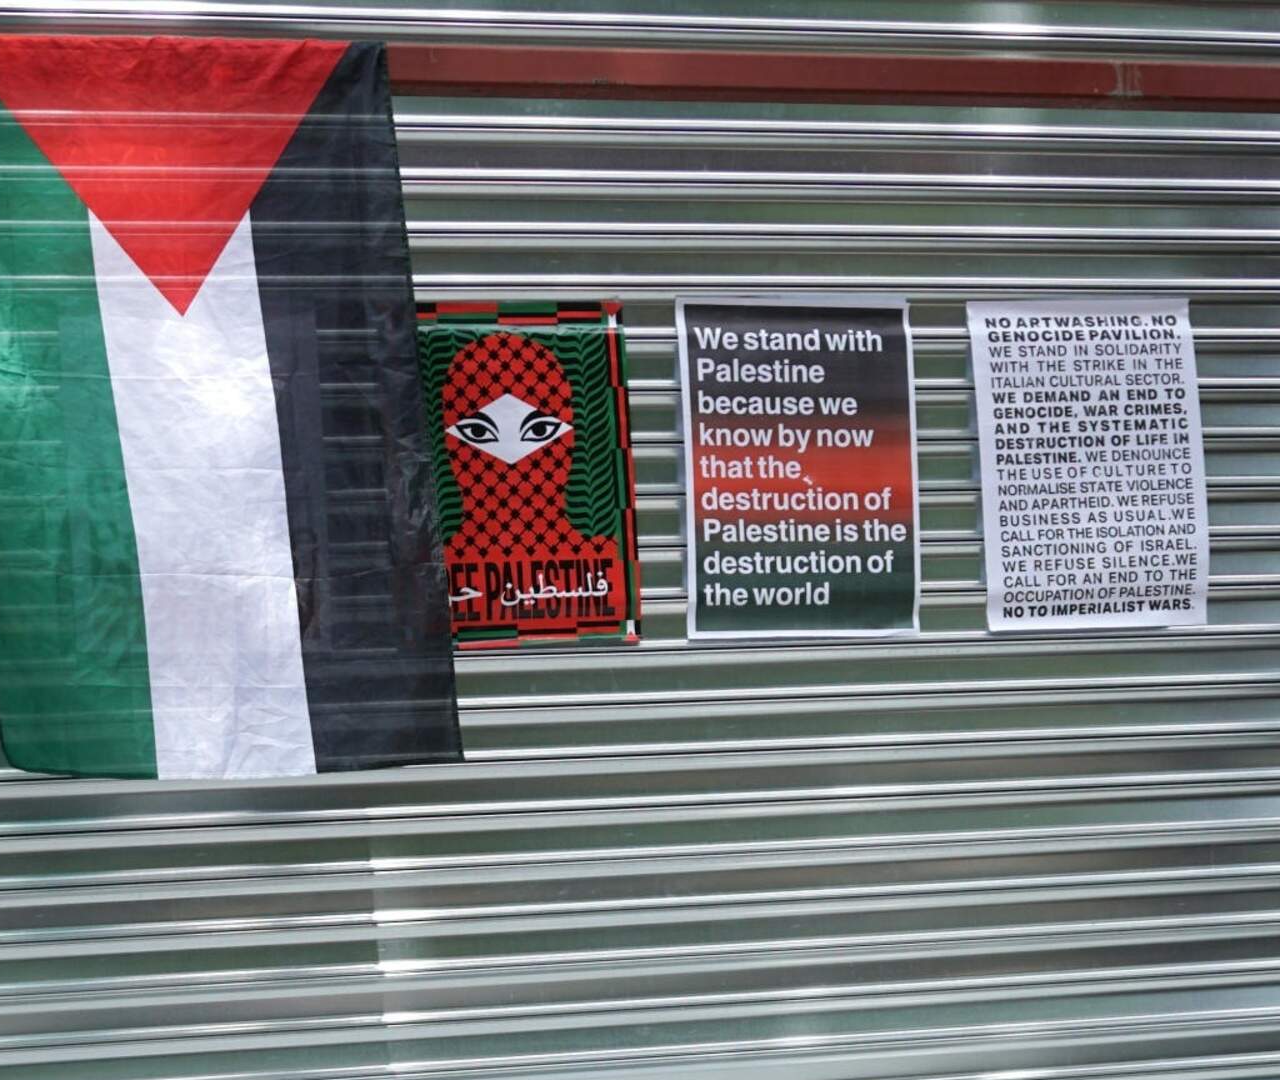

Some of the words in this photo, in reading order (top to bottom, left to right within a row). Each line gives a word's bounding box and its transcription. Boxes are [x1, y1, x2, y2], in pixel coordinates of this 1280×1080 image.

[985, 317, 1011, 329] NO
[1016, 315, 1149, 328] ARTWASHING.
[1152, 315, 1177, 327] NO
[694, 327, 738, 350] We
[744, 329, 820, 351] stand
[825, 329, 882, 352] with
[988, 330, 1086, 343] GENOCIDE
[1090, 329, 1181, 341] PAVILION.
[989, 346, 1012, 358] WE
[1018, 345, 1067, 357] STAND
[1074, 345, 1088, 356] IN
[1095, 343, 1182, 356] SOLIDARITY
[697, 358, 825, 383] Palestine
[990, 361, 1028, 373] WITH
[1038, 360, 1066, 372] THE
[1074, 359, 1125, 372] STRIKE
[1133, 359, 1147, 370] IN
[1155, 358, 1183, 370] THE
[991, 376, 1045, 389] ITALIAN
[1050, 375, 1120, 387] CULTURAL
[1125, 373, 1184, 386] SECTOR.
[698, 390, 814, 415] because
[820, 397, 858, 415] we
[993, 392, 1016, 404] WE
[1023, 390, 1090, 403] DEMAND
[1099, 389, 1120, 401] AN
[1127, 389, 1157, 400] END
[1165, 388, 1185, 400] TO
[993, 407, 1078, 420] GENOCIDE,
[1084, 405, 1118, 417] WAR
[1124, 403, 1187, 416] CRIMES,
[995, 422, 1030, 434] AND
[1038, 421, 1071, 433] THE
[1078, 418, 1188, 432] SYSTEMATIC
[700, 423, 773, 447] know
[778, 424, 811, 453] by
[817, 429, 874, 447] now
[996, 435, 1105, 450] DESTRUCTION
[1111, 435, 1130, 447] OF
[1137, 434, 1168, 446] LIFE
[1174, 433, 1189, 445] IN
[996, 452, 1082, 465] PALESTINE.
[1085, 451, 1107, 463] WE
[1112, 448, 1190, 462] DENOUNCE
[700, 455, 752, 479] that
[757, 456, 801, 479] the
[998, 468, 1026, 481] THE
[1032, 467, 1062, 479] USE
[1067, 466, 1087, 478] OF
[1093, 464, 1166, 478] CULTURE
[1171, 463, 1192, 475] TO
[998, 482, 1076, 497] NORMALISE
[1080, 481, 1122, 493] STATE
[1126, 478, 1193, 491] VIOLENCE
[701, 487, 858, 511] destruction
[864, 487, 891, 511] of
[999, 499, 1028, 512] AND
[1032, 496, 1114, 511] APARTHEID.
[1117, 496, 1139, 507] WE
[1142, 493, 1194, 506] REFUSE
[1000, 512, 1081, 527] BUSINESS
[1088, 511, 1107, 523] AS
[704, 519, 830, 542] Palestine
[835, 520, 858, 542] is
[863, 520, 906, 542] the
[1001, 530, 1034, 543] CALL
[1038, 529, 1064, 541] FOR
[1067, 528, 1092, 539] THE
[1096, 525, 1165, 539] ISOLATION
[1168, 523, 1196, 535] AND
[1001, 542, 1107, 558] SANCTIONING
[1114, 540, 1133, 553] OF
[1141, 538, 1197, 552] ISRAEL.
[704, 551, 861, 574] destruction
[867, 550, 894, 574] of
[1003, 561, 1026, 573] WE
[1034, 558, 1095, 571] REFUSE
[1003, 576, 1041, 588] CALL
[1047, 574, 1077, 586] FOR
[1084, 572, 1105, 584] AN
[1109, 571, 1139, 584] END
[1146, 570, 1164, 582] TO
[1169, 569, 1197, 581] THE
[446, 562, 481, 622] EE
[484, 559, 615, 620] PALESTINE
[500, 571, 609, 606] فلسطين
[704, 583, 748, 607] the
[752, 582, 829, 606] world
[1004, 589, 1093, 603] OCCUPATION
[1098, 587, 1116, 600] OF
[1120, 584, 1195, 598] PALESTINE.
[1003, 606, 1024, 618] NO
[1028, 605, 1048, 617] TO
[1051, 601, 1145, 616] IMPERIALIST
